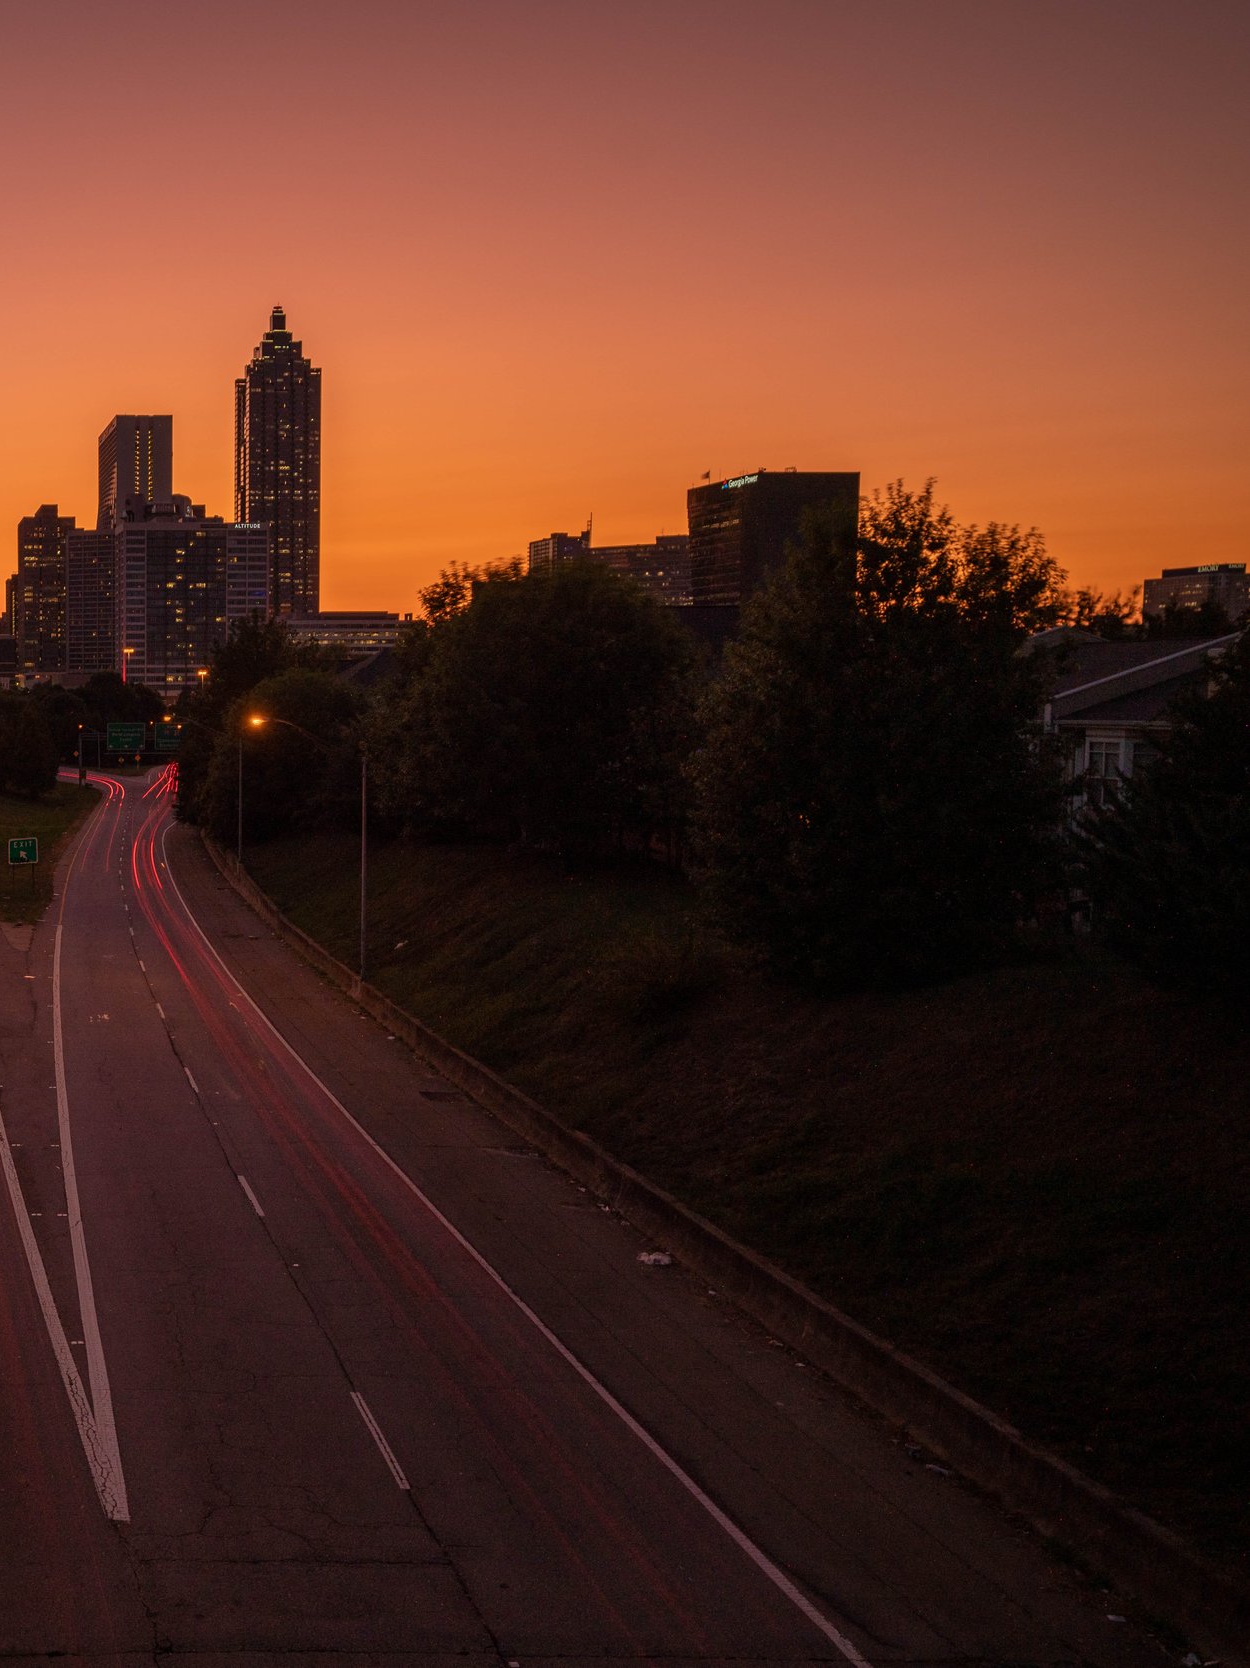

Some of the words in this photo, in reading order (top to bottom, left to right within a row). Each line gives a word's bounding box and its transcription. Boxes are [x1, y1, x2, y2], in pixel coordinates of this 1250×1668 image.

[728, 477, 744, 488] Georgia
[745, 475, 758, 484] Power
[1198, 564, 1219, 573] EMORY
[13, 841, 32, 849] EXIT
